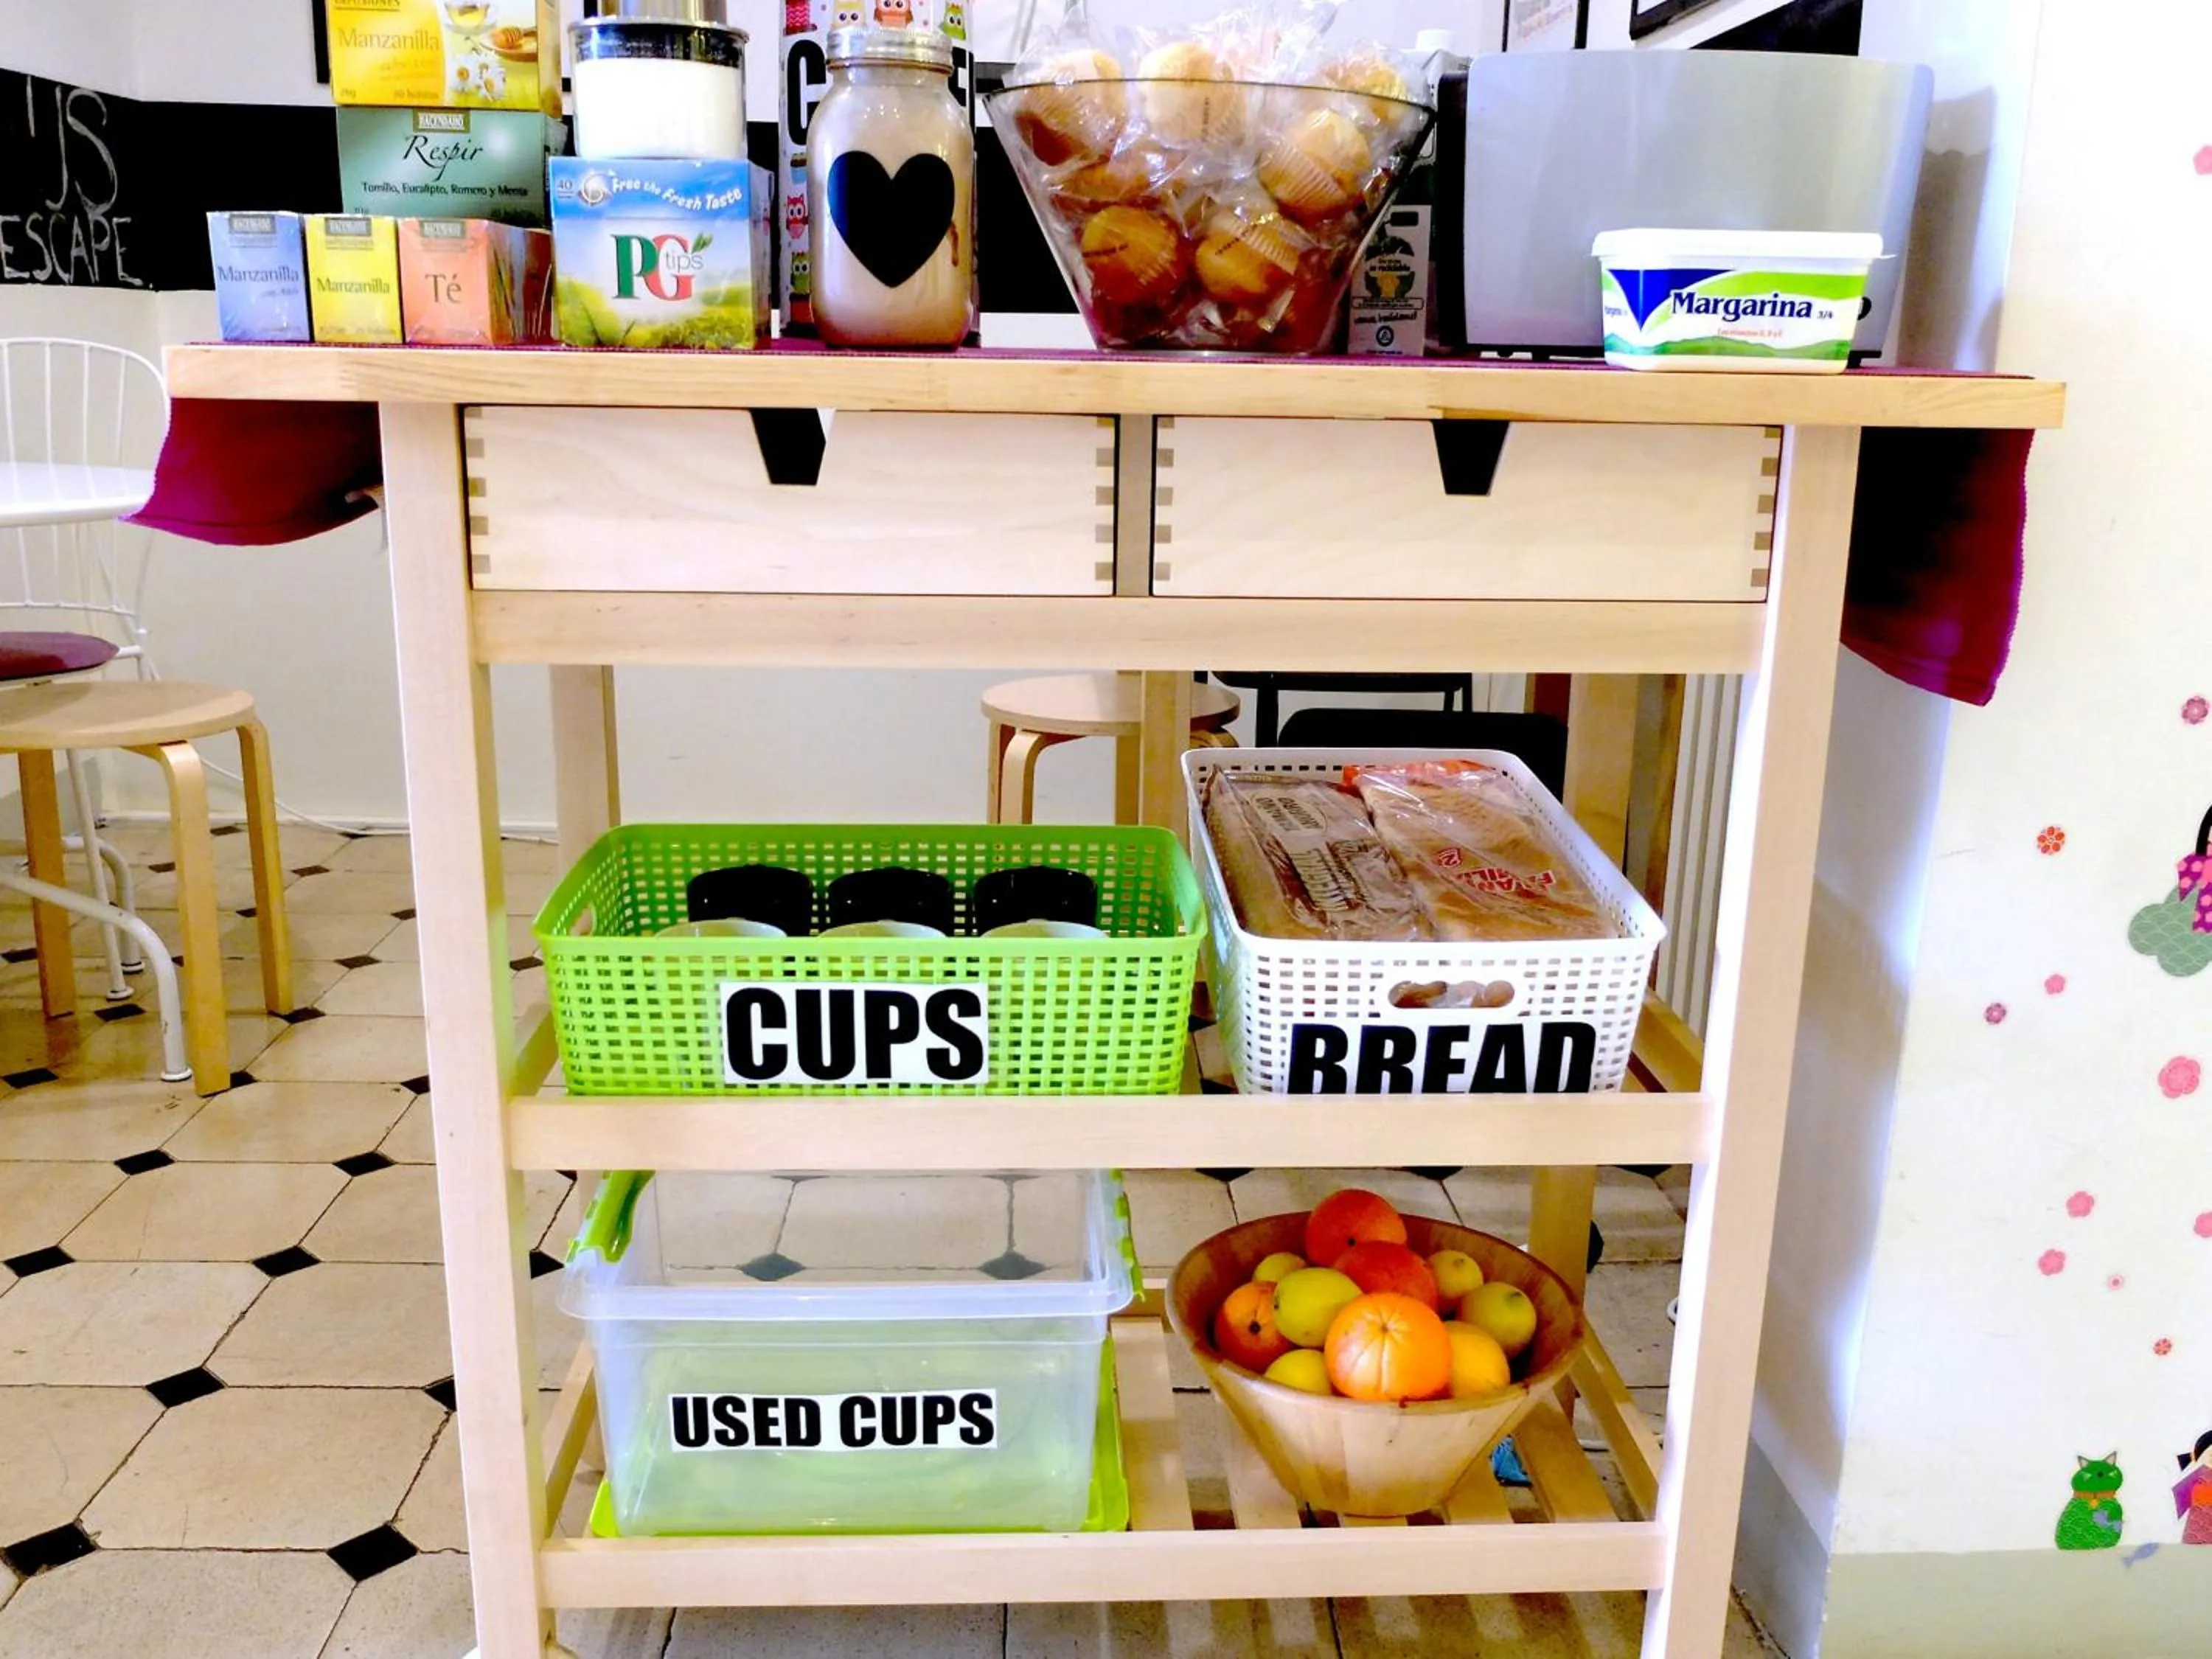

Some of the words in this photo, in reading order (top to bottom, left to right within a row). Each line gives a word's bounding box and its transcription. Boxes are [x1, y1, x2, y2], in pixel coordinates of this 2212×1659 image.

[337, 27, 439, 51] Manzanilla
[403, 135, 483, 182] Respir
[451, 184, 487, 195] Romero
[489, 188, 496, 197] y
[612, 177, 641, 193] Free
[661, 188, 702, 210] Fresh
[706, 188, 742, 210] Taste
[218, 265, 299, 283] Manzanilla
[610, 234, 695, 301] PG
[666, 251, 703, 273] tips
[316, 276, 391, 294] Manzanilla
[425, 273, 462, 304] Té
[1672, 291, 1812, 322] Margarina
[726, 987, 984, 1080] CUPS
[1287, 1021, 1596, 1094] BREAD
[672, 1395, 821, 1447] USED
[839, 1393, 994, 1447] CUPS
